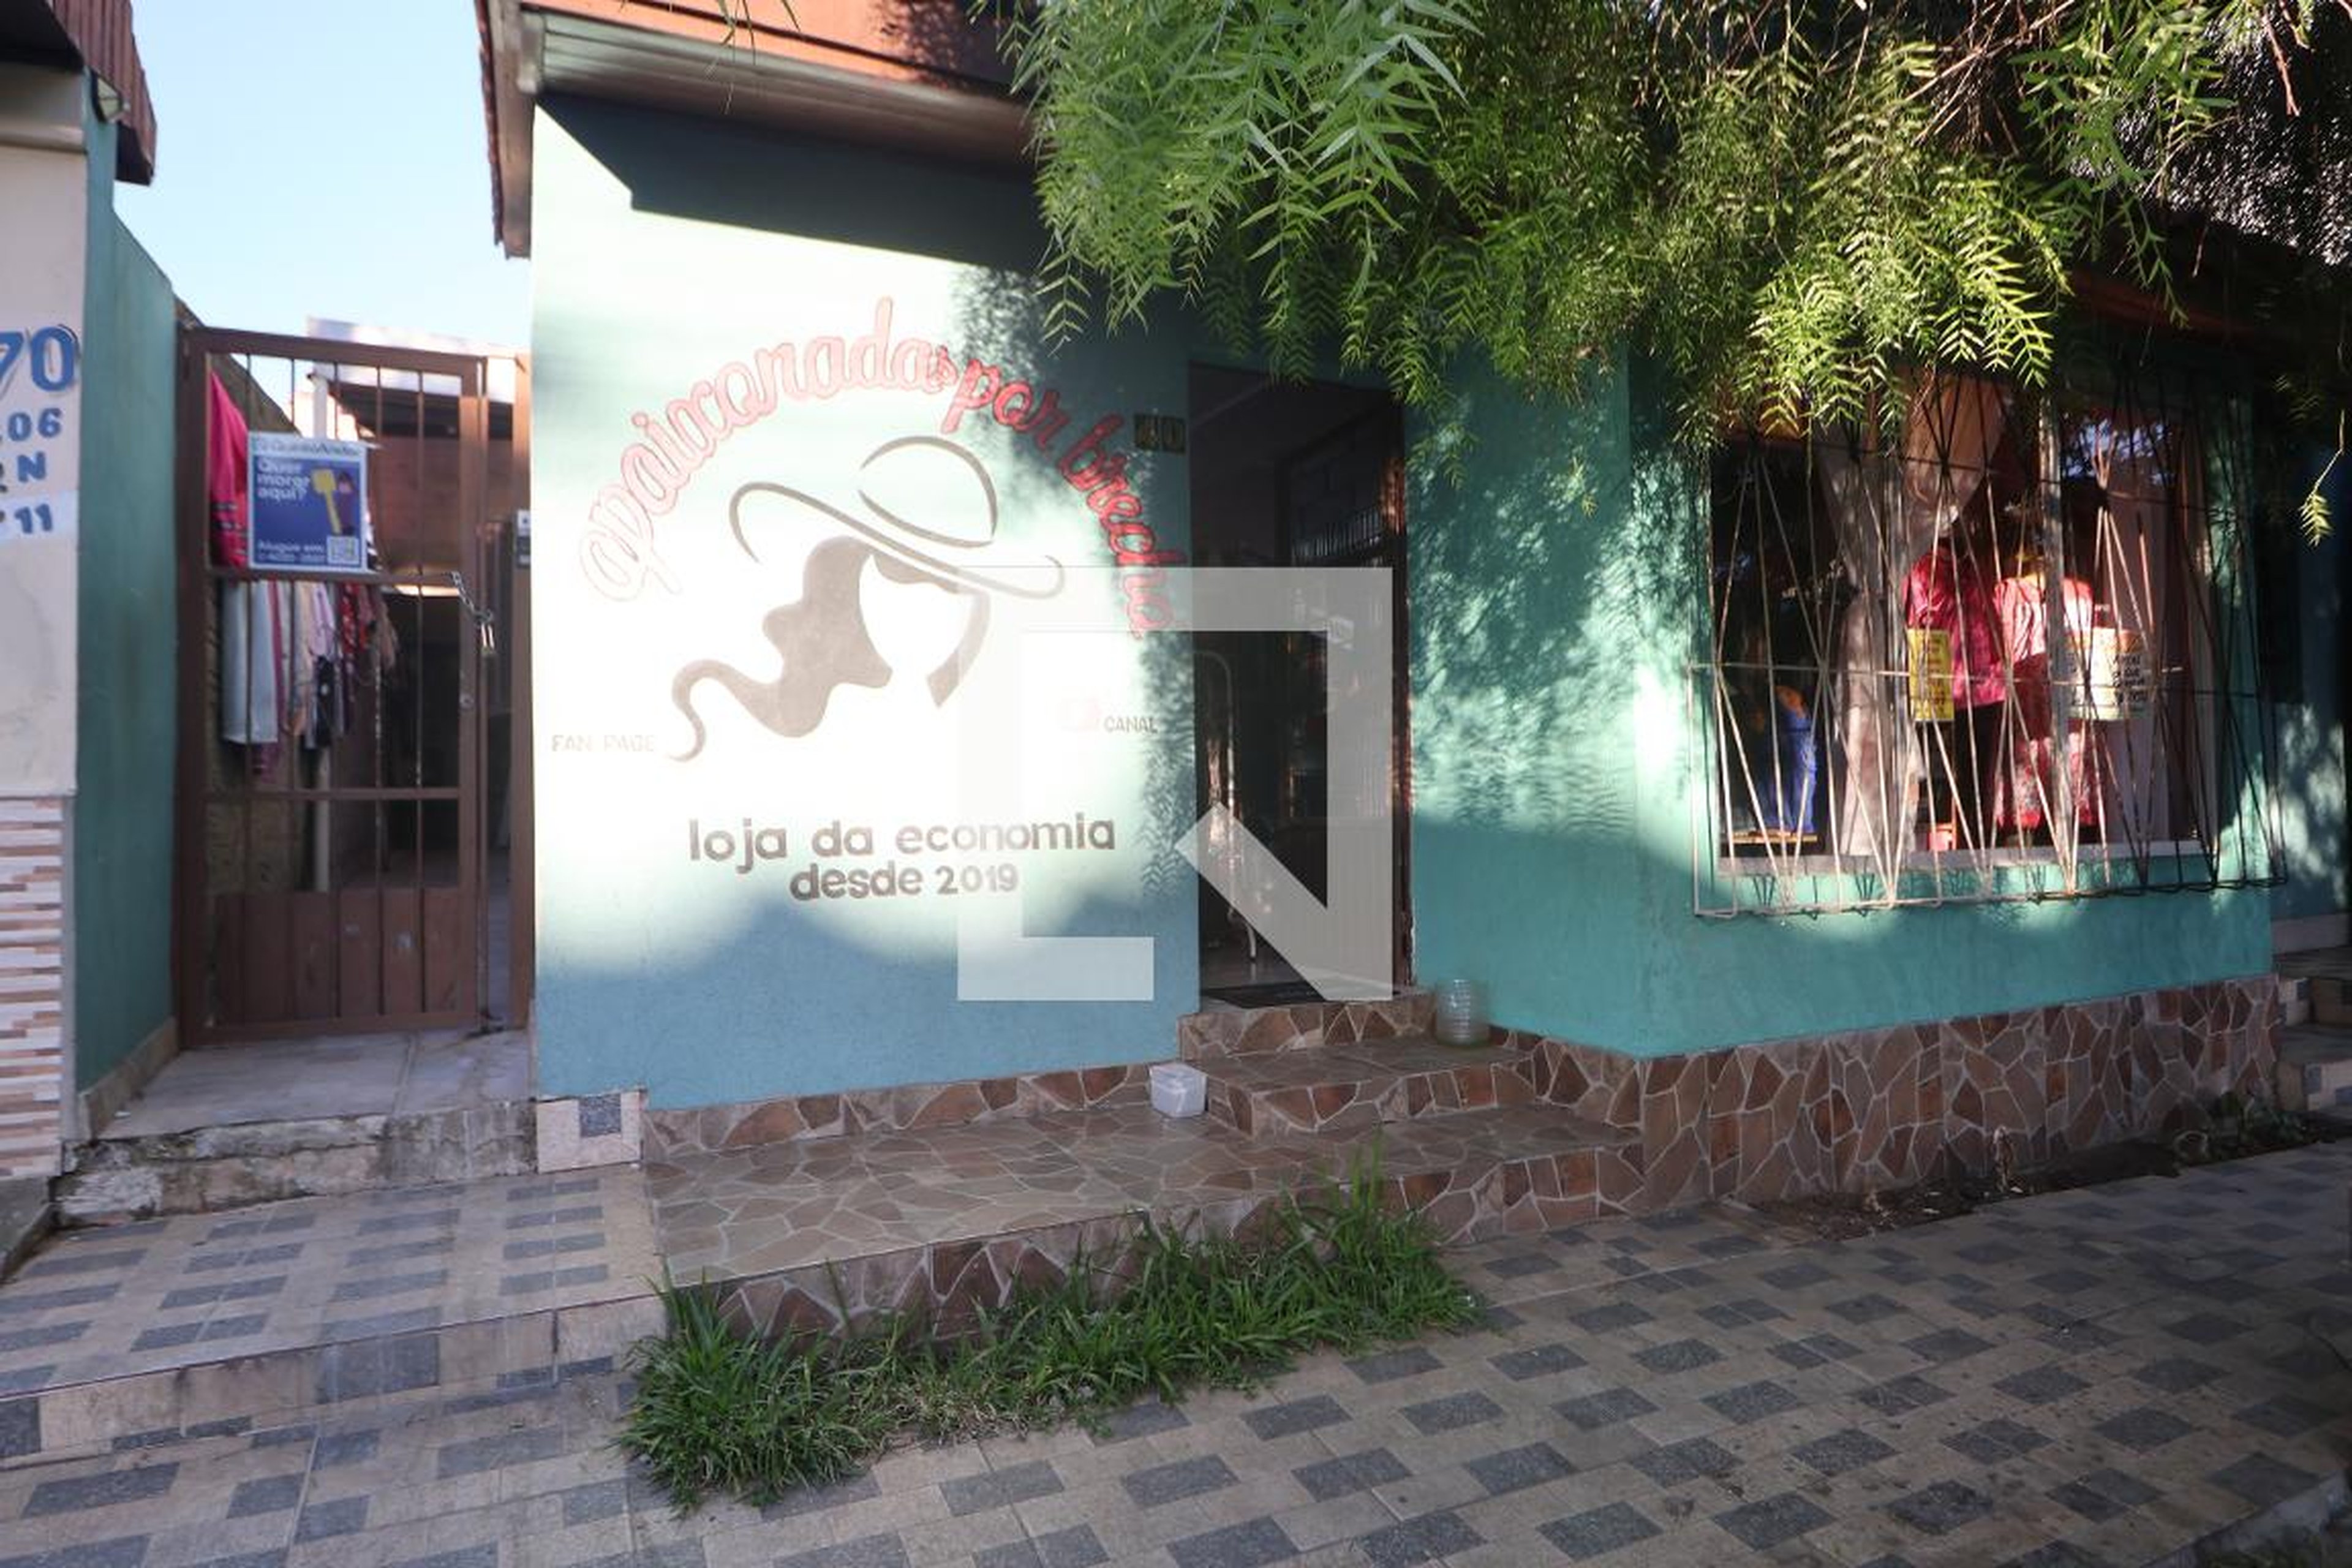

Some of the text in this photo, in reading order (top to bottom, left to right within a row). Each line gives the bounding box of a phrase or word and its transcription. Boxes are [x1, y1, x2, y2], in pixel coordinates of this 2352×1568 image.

[941, 358, 1069, 451] por
[0, 503, 52, 533] 11
[1104, 716, 1158, 733] CANAL
[552, 734, 593, 752] FAN
[689, 812, 1115, 874] loja da economia
[790, 861, 1019, 900] desde 2019
